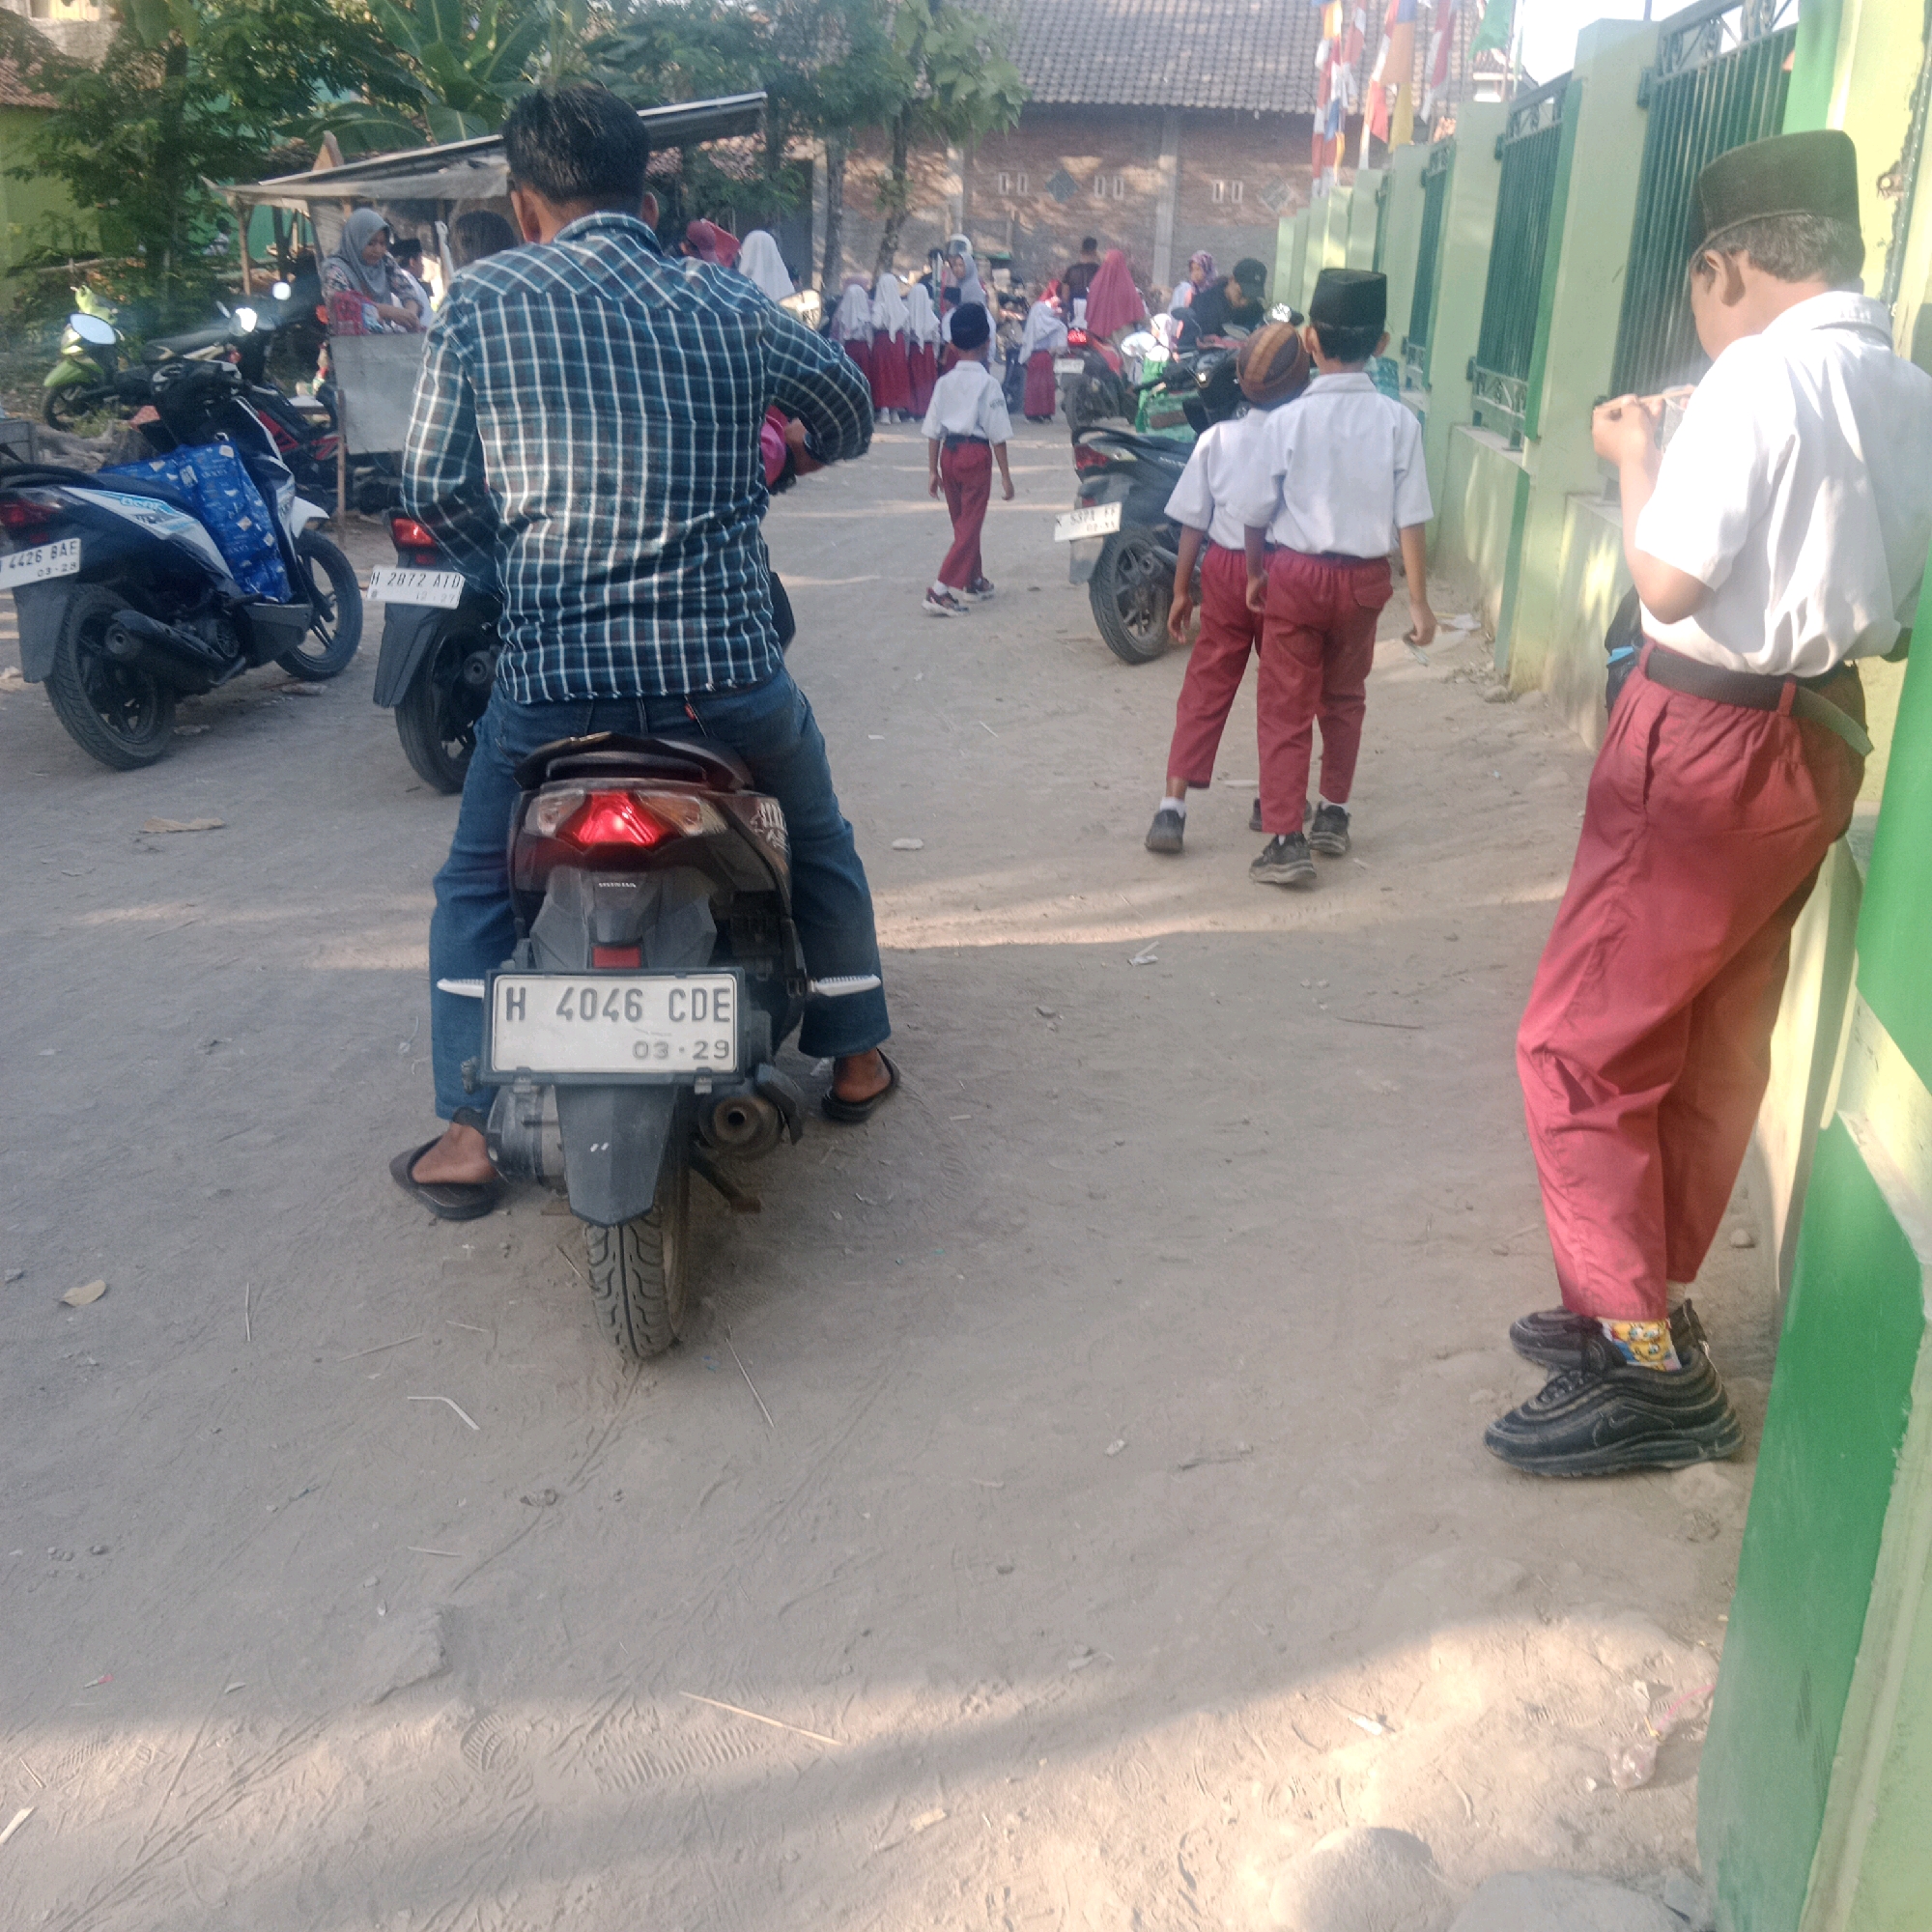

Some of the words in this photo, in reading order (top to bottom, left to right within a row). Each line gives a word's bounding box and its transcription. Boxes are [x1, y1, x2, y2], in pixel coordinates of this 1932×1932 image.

[9, 549, 43, 569] 4426
[371, 571, 381, 585] H
[387, 572, 427, 587] 2872
[505, 986, 526, 1022] H
[555, 986, 644, 1023] 4046
[668, 987, 731, 1023] CDE
